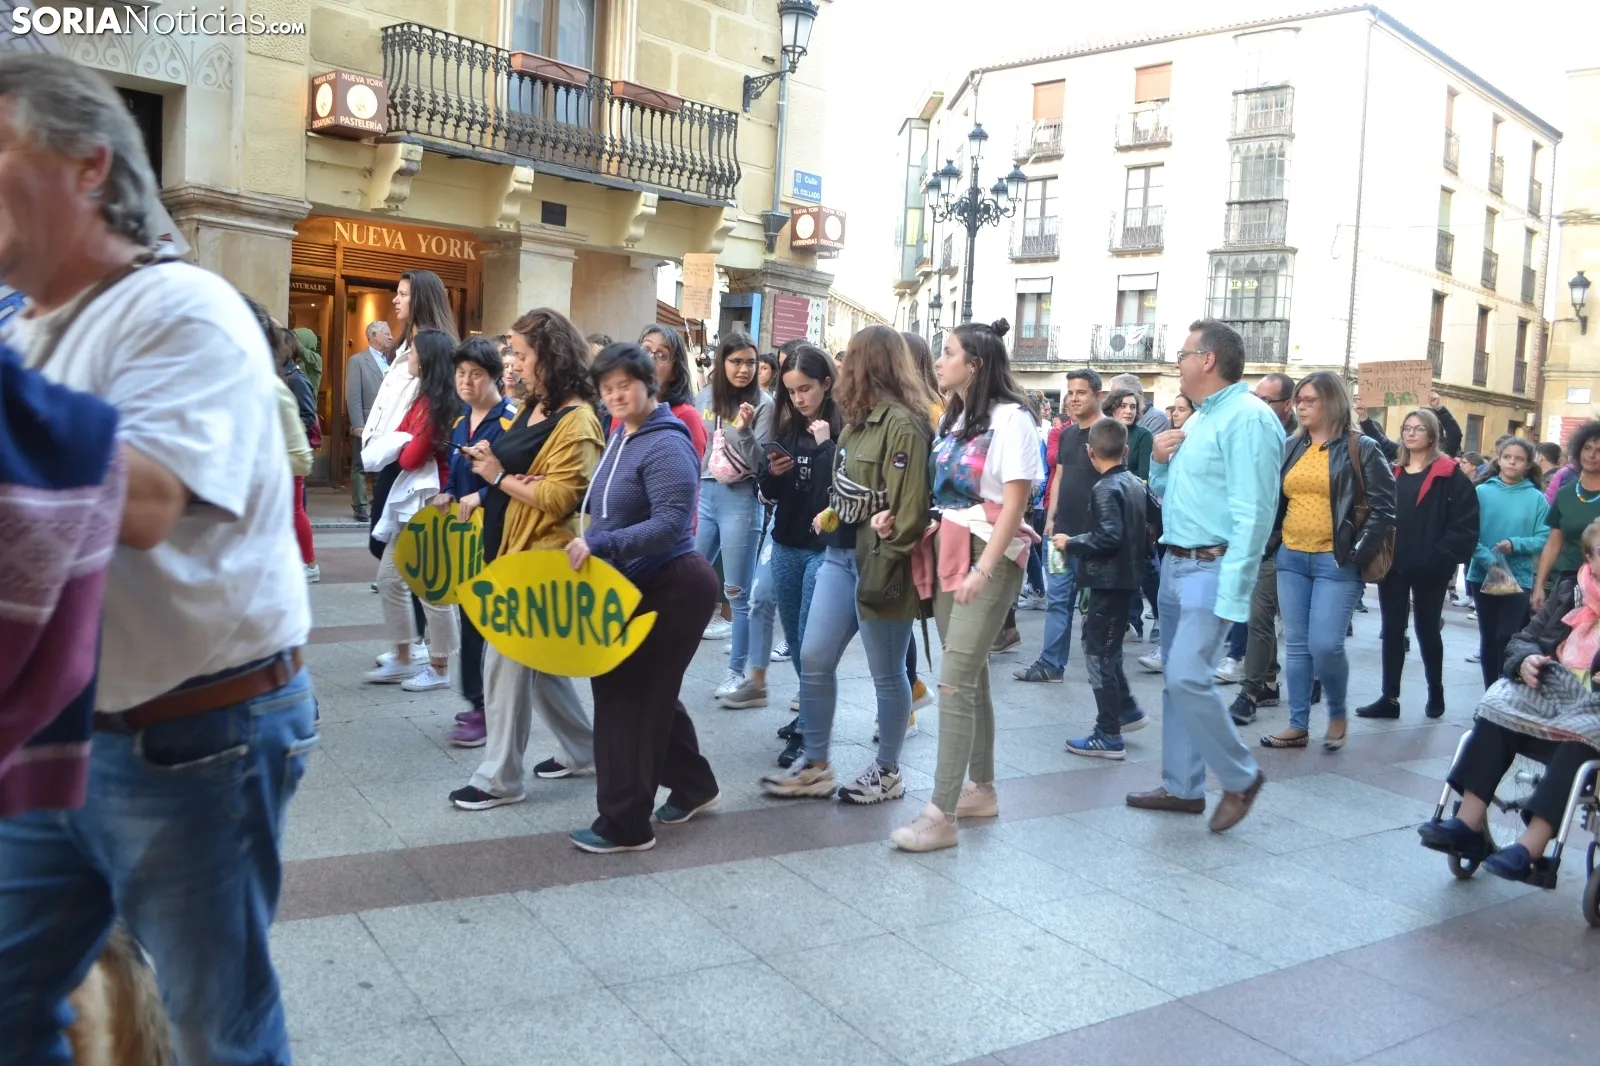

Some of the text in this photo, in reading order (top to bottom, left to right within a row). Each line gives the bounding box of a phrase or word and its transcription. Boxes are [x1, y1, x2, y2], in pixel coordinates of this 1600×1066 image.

[341, 73, 384, 88] NUEVA YORK
[340, 116, 383, 131] PASTELERÍA
[804, 176, 818, 186] Calle
[800, 188, 820, 199] COLLADO
[333, 220, 477, 261] NUEVA YORK
[792, 238, 818, 247] MERIENDAS
[472, 579, 628, 647] TERNURA
